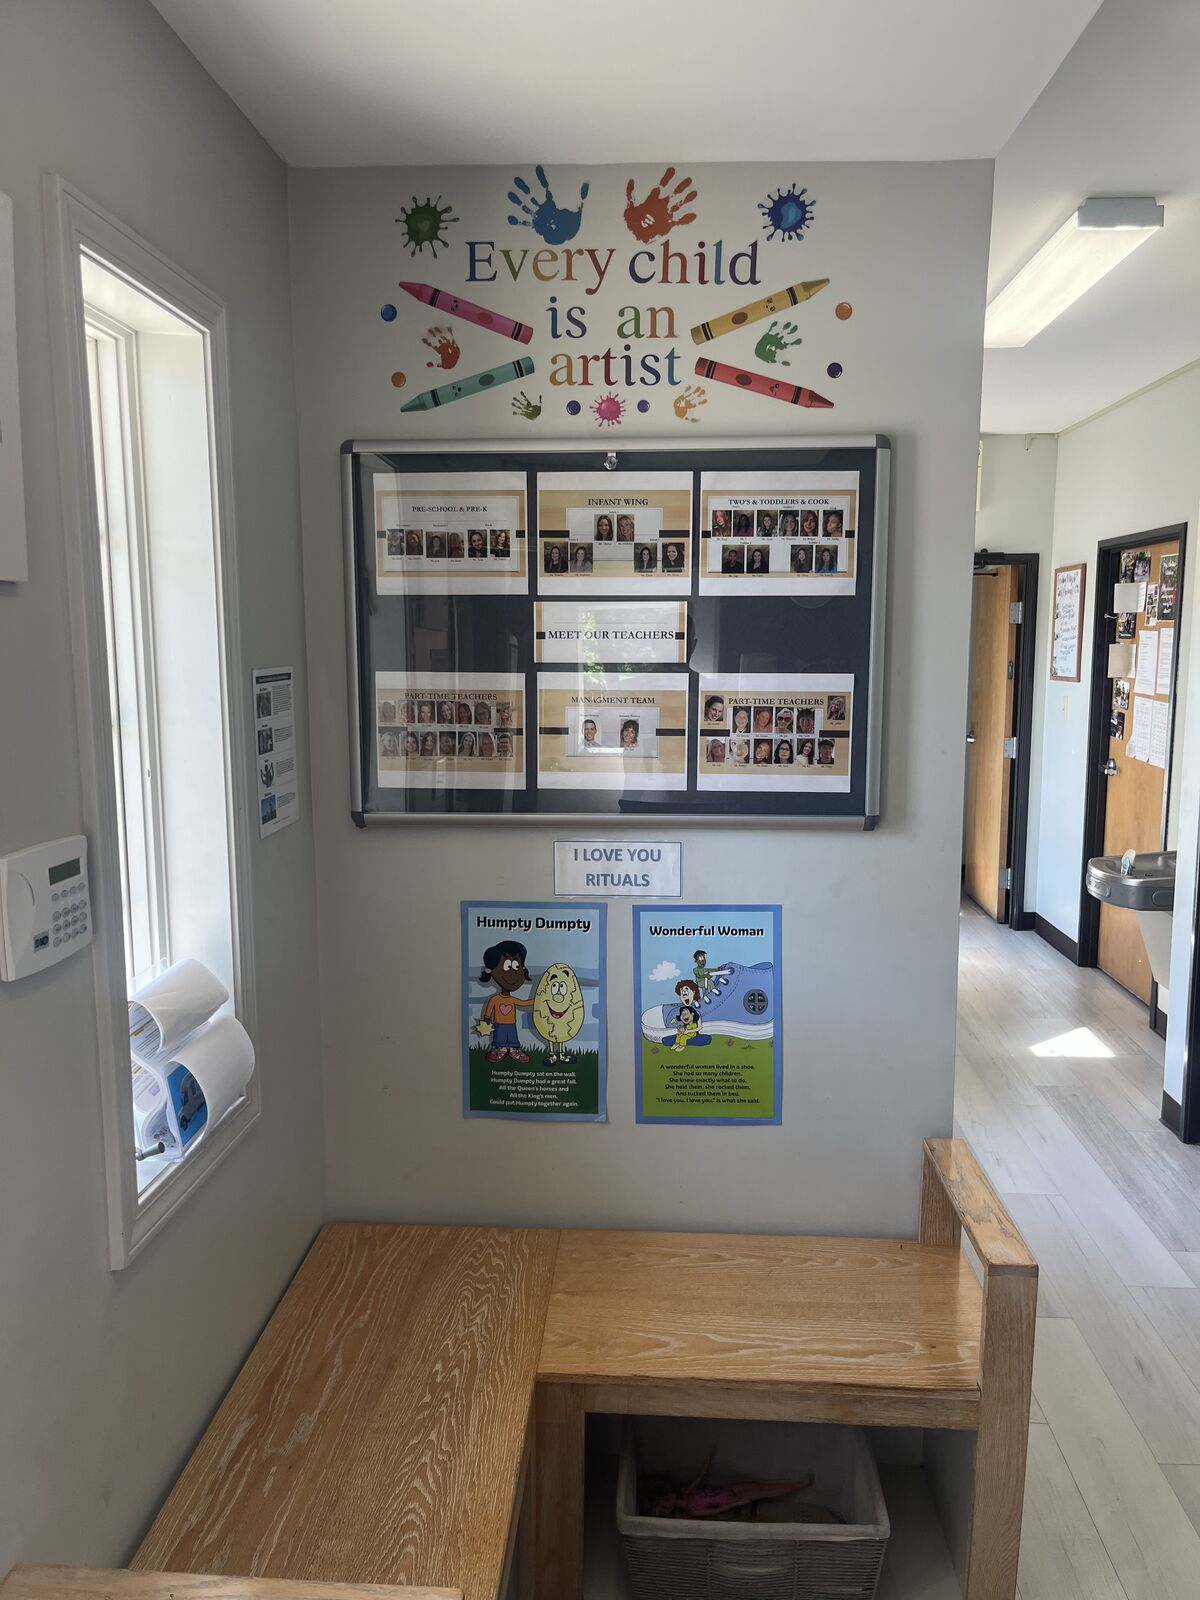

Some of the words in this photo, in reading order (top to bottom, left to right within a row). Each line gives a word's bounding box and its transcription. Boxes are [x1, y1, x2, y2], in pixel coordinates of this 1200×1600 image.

[465, 241, 616, 296] Every
[629, 239, 761, 286] child
[547, 296, 587, 339] is
[617, 305, 679, 339] an
[549, 345, 682, 387] artist
[549, 631, 581, 640] MEET
[585, 631, 609, 640] OUR
[612, 631, 674, 640] TEACHERS
[574, 848, 578, 861] I
[583, 848, 623, 862] LOVE
[627, 849, 662, 862] YOU
[586, 874, 650, 887] RITUALS
[477, 916, 532, 931] Humpty
[536, 918, 591, 932] Dumpty
[650, 926, 715, 936] Wonderful
[718, 926, 764, 936] Woman
